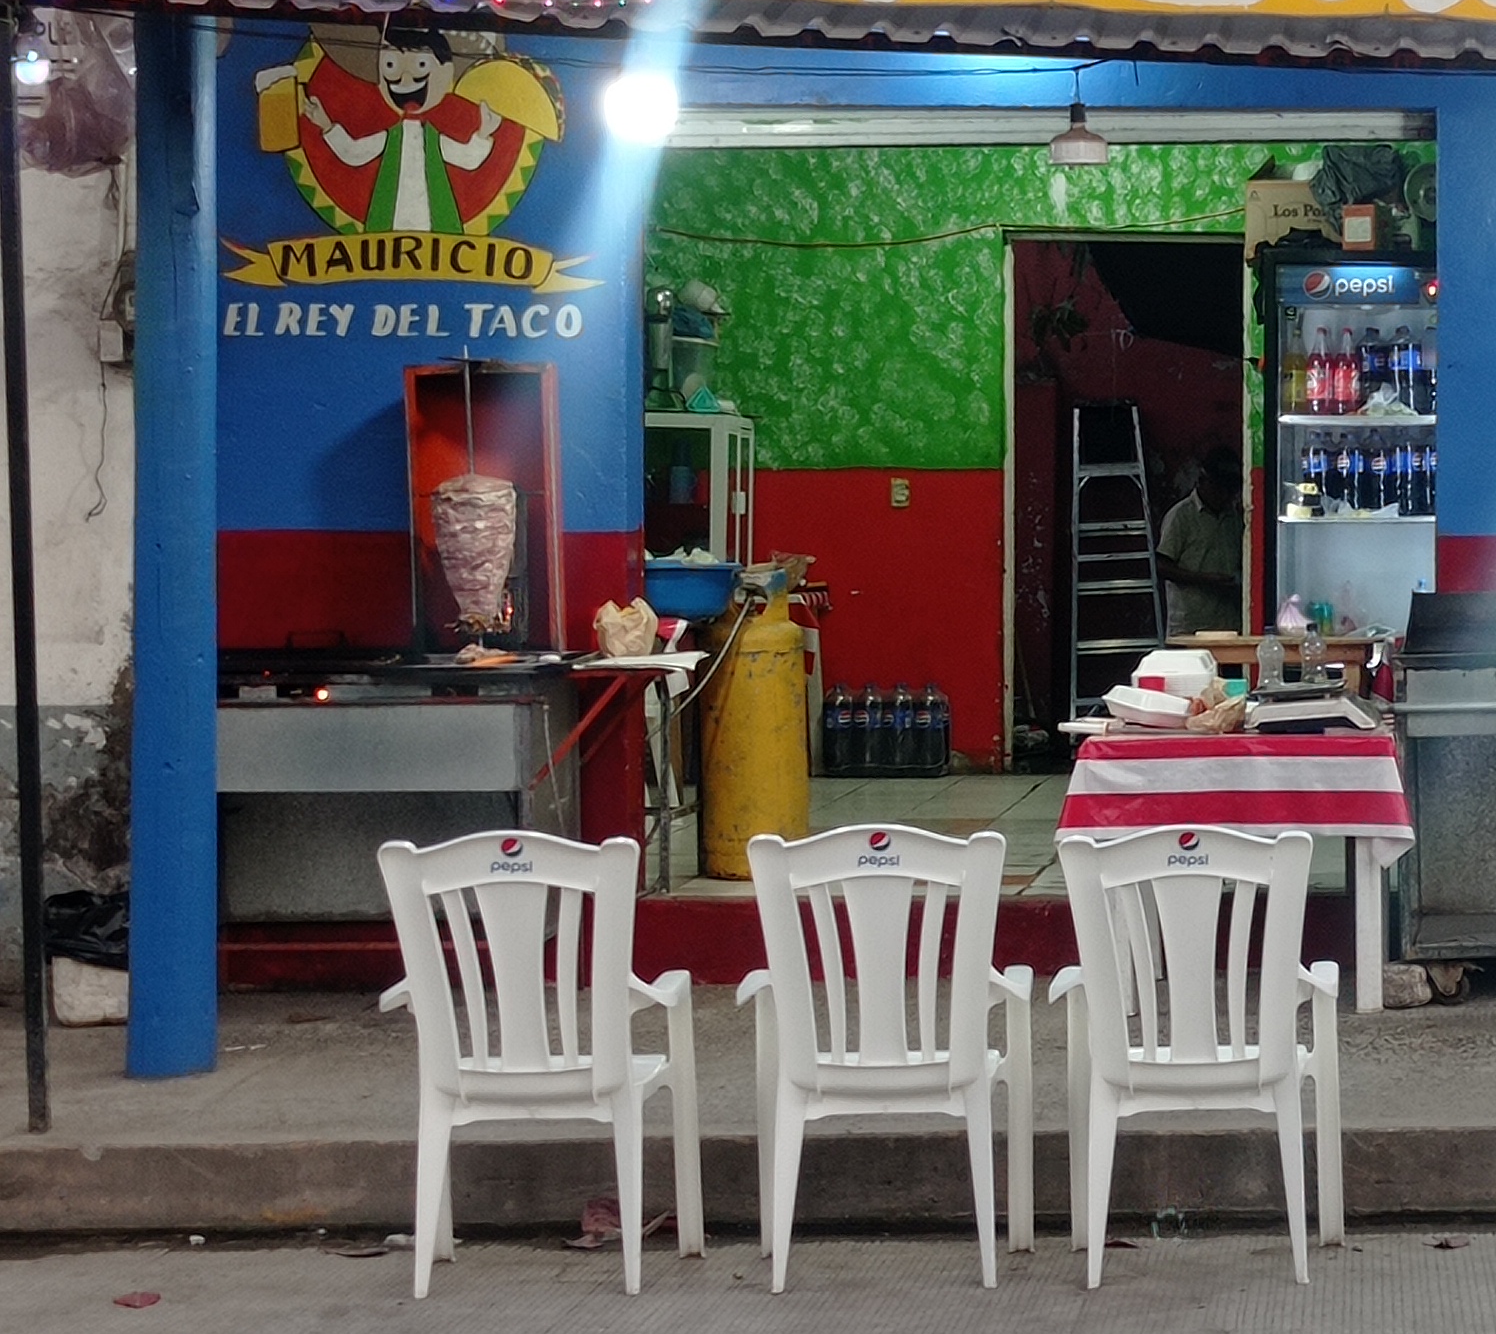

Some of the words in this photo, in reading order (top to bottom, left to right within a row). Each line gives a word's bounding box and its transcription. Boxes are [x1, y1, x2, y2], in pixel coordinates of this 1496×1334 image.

[1273, 204, 1298, 217] Los
[279, 235, 535, 279] MAURICIO
[1334, 274, 1394, 297] pepsi
[223, 302, 264, 337] EL
[274, 302, 355, 338] REY
[370, 302, 451, 337] DEL
[463, 303, 584, 339] TACO
[490, 860, 533, 873] pepsi
[857, 854, 900, 867] pepsi
[1167, 853, 1209, 867] pepsi
